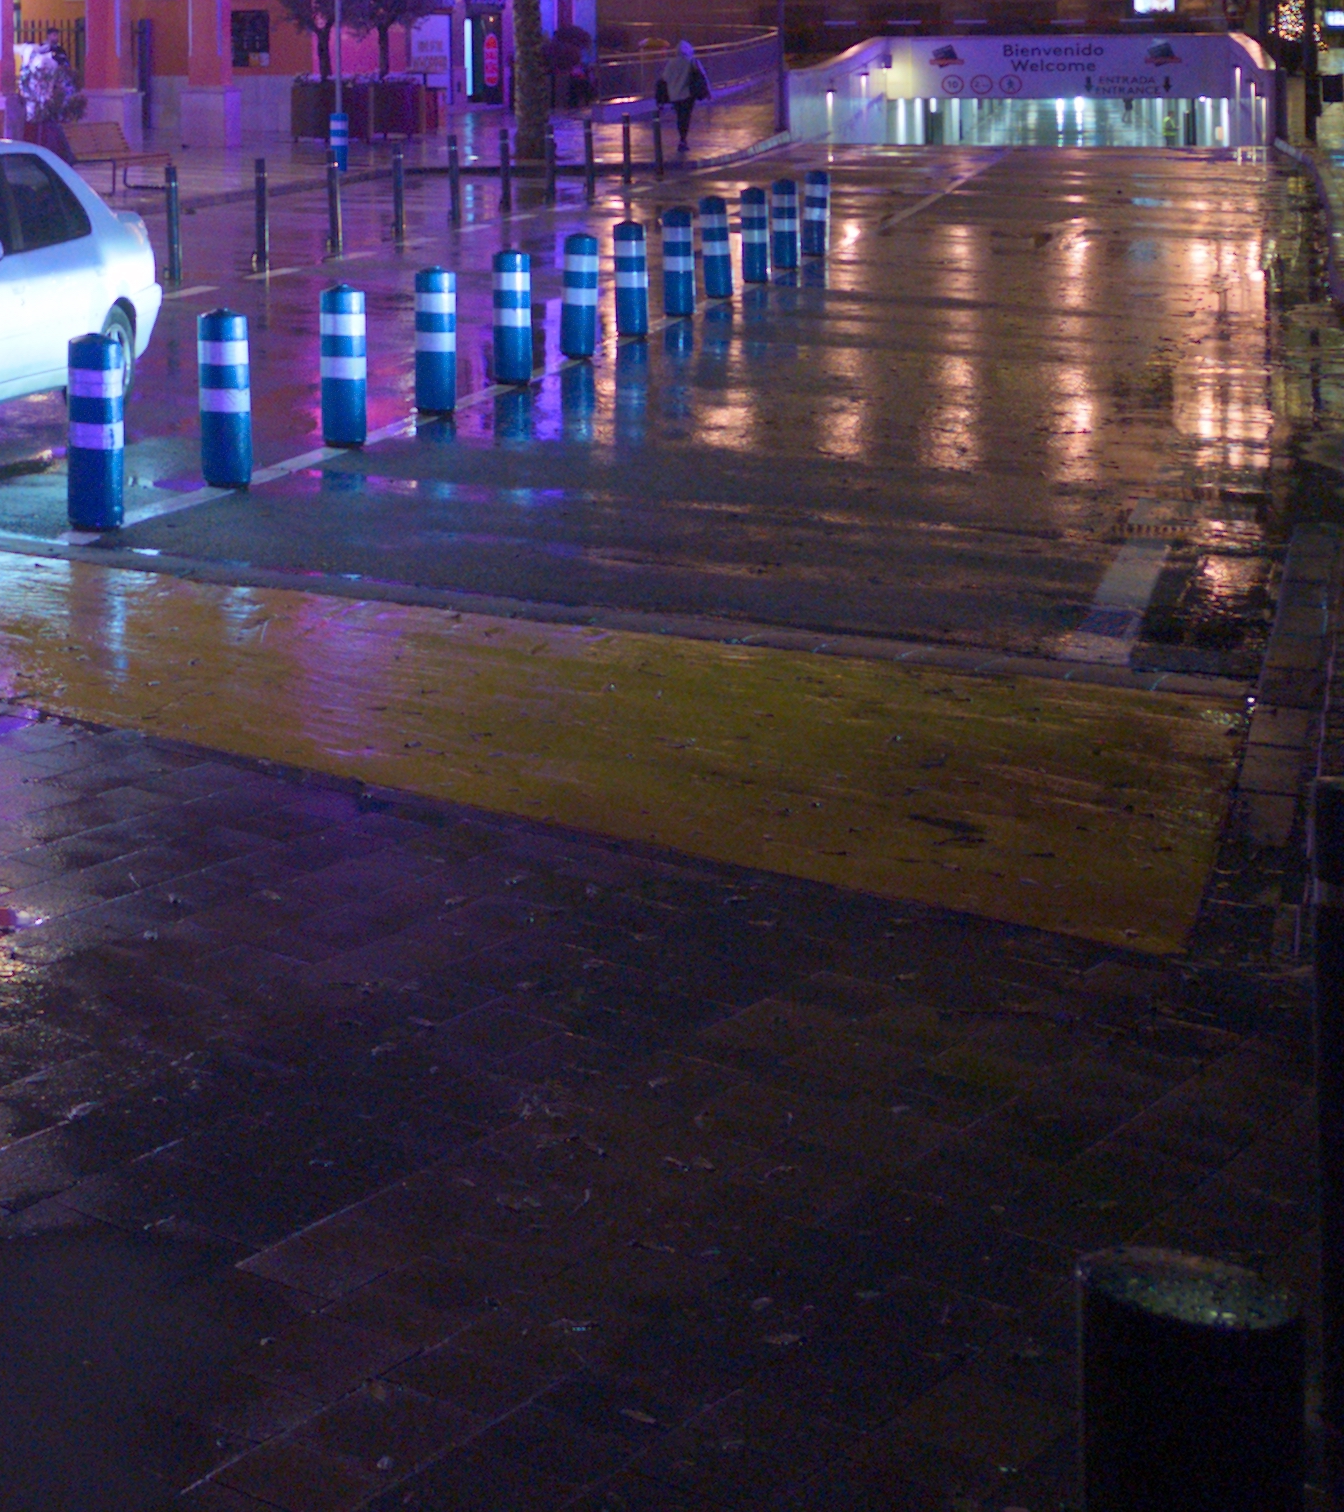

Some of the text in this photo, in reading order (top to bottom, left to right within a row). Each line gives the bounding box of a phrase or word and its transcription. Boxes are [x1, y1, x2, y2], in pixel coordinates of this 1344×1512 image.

[1002, 43, 1105, 57] Bienvenido
[1011, 59, 1097, 72] Welcome
[1098, 76, 1156, 85] ENTRADA
[1095, 86, 1161, 95] ENTRANCE
